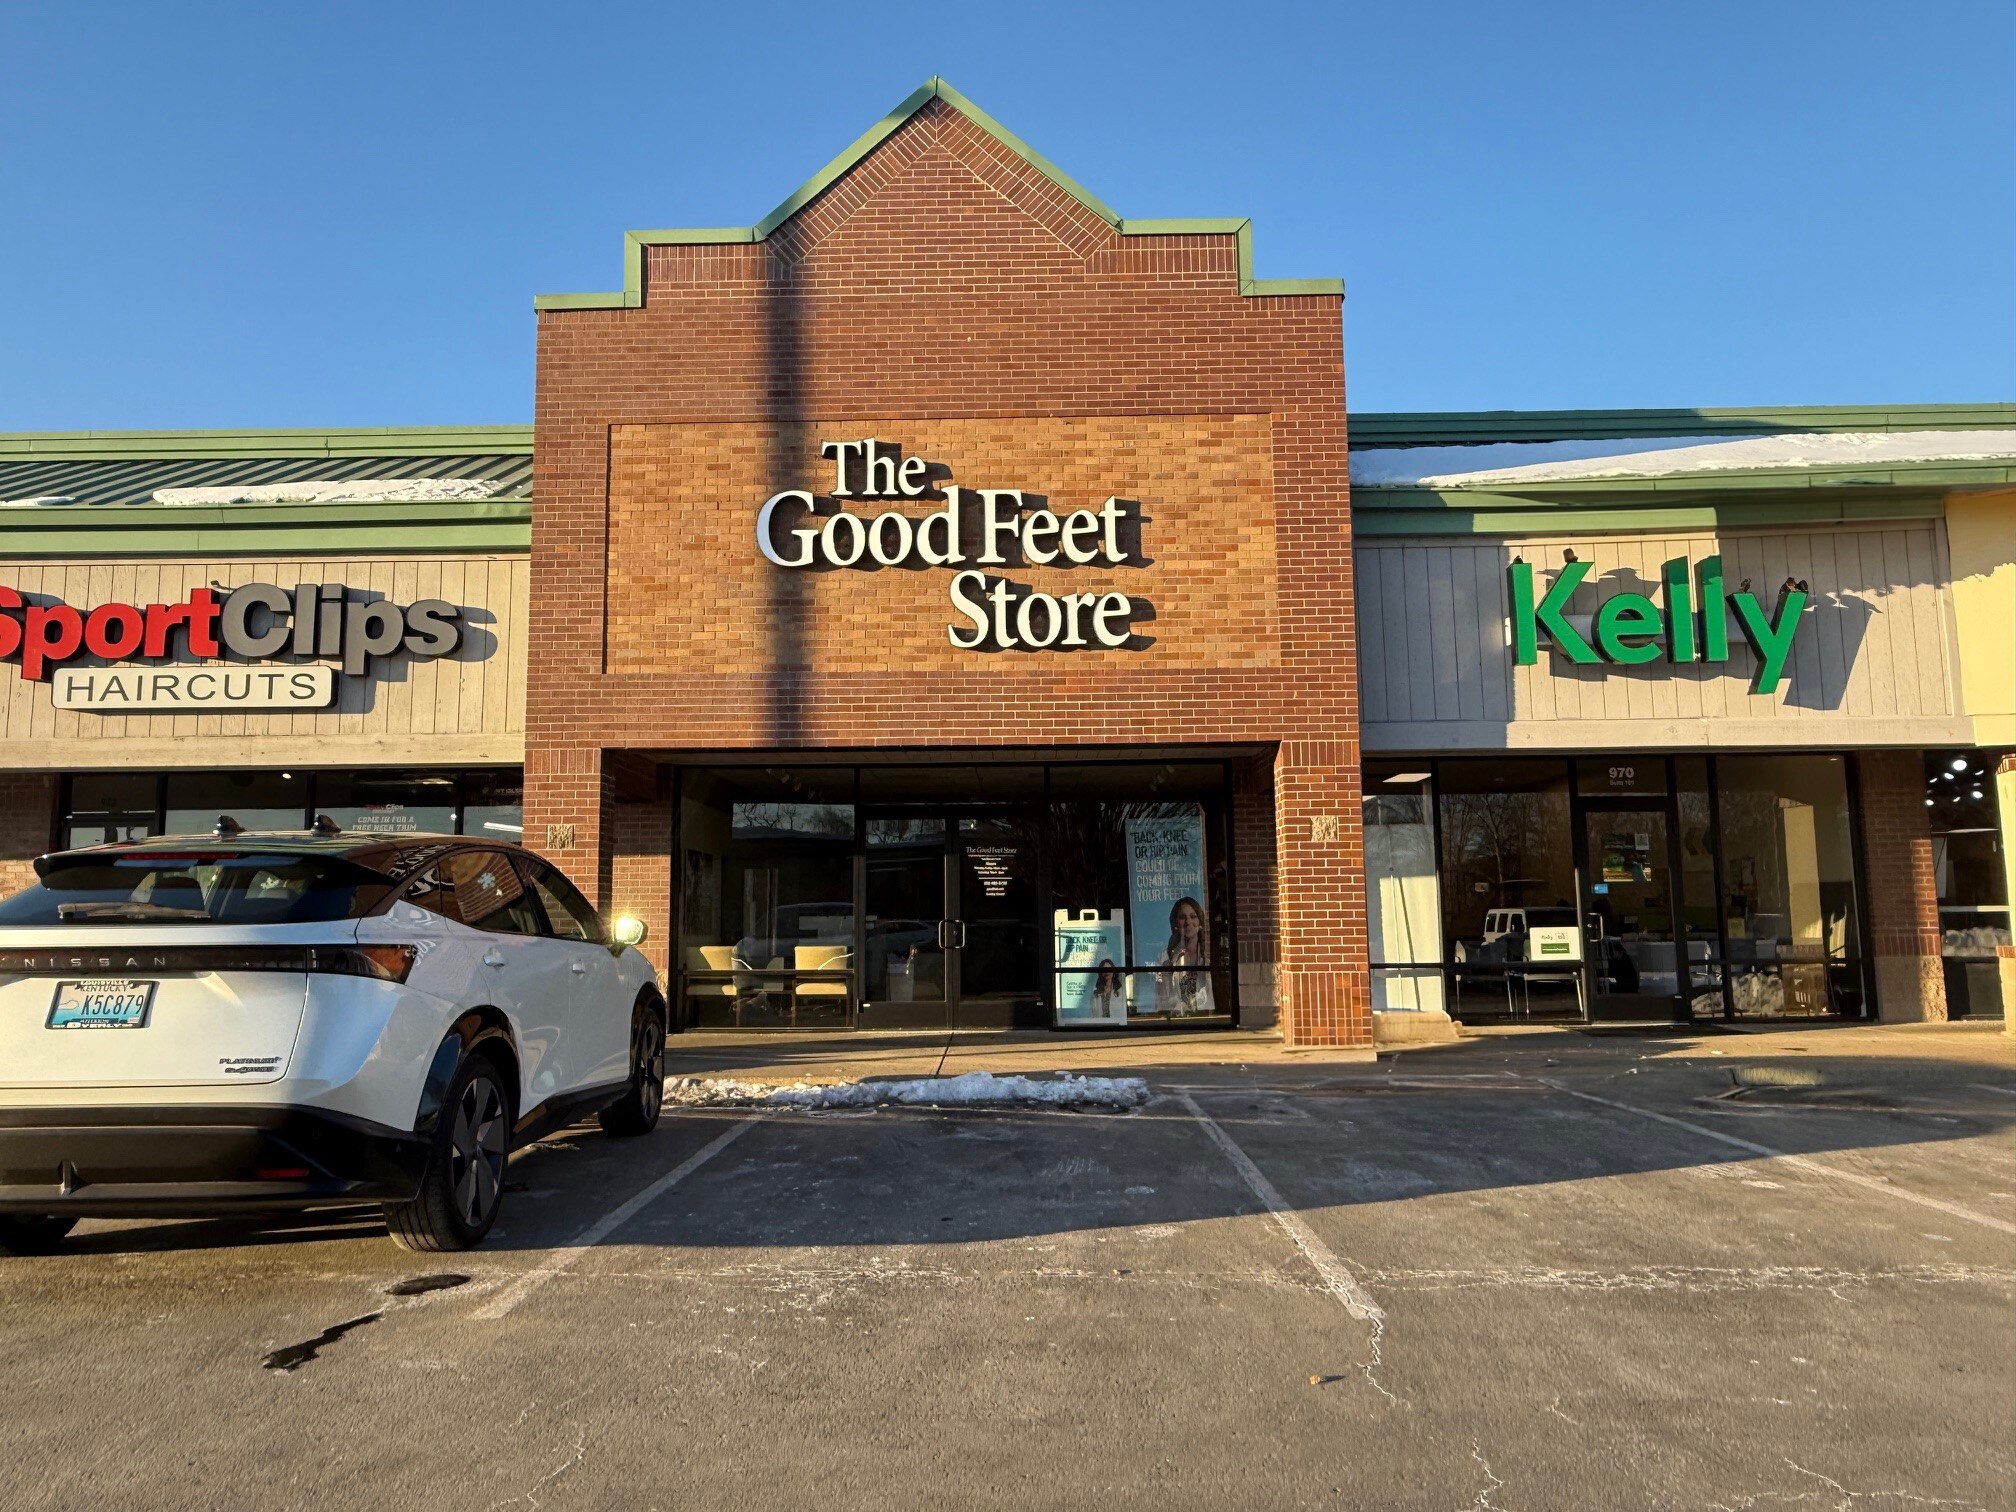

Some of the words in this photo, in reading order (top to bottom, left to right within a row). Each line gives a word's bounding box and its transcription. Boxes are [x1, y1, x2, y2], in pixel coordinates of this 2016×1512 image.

[821, 437, 926, 497] The
[756, 485, 966, 567] Good
[975, 488, 1129, 565] Feet
[947, 569, 1132, 649] Store
[1507, 555, 1809, 695] Kelly
[65, 673, 317, 702] HAIRCUTS
[1608, 766, 1635, 779] 970
[1135, 845, 1148, 859] OR
[1136, 888, 1162, 902] YOUR
[24, 957, 166, 967] NISSAN
[81, 994, 144, 1016] K5C879
